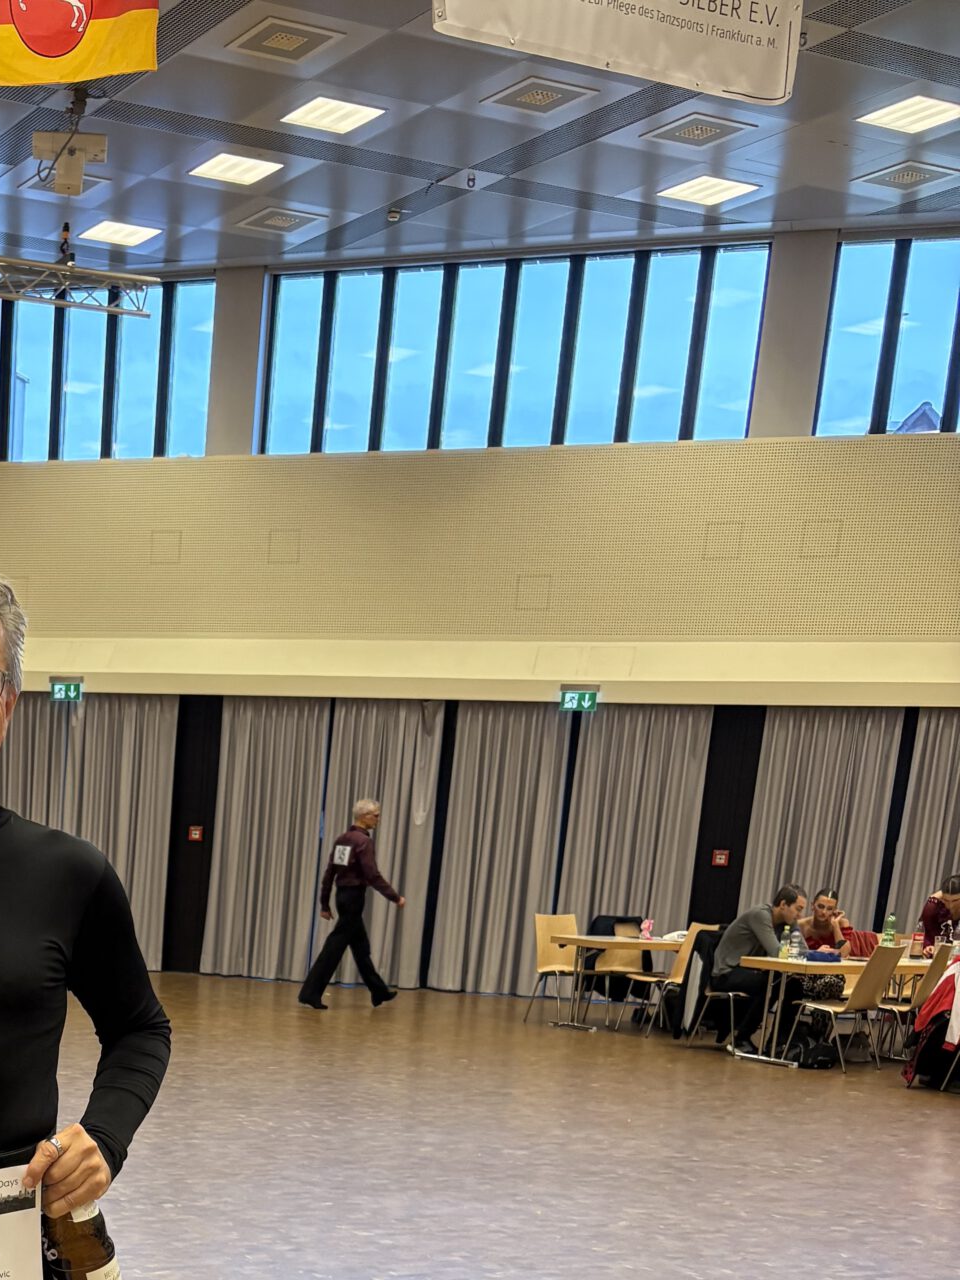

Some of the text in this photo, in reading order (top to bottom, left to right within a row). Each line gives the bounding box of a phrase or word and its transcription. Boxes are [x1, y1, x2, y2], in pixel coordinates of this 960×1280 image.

[607, 0, 637, 15] Pflege
[638, 5, 655, 20] des
[656, 9, 705, 33] Tanzsports
[711, 25, 754, 46] Frankfurt
[755, 36, 765, 47] a.
[767, 37, 779, 49] M.
[749, 1, 780, 28] E.V.
